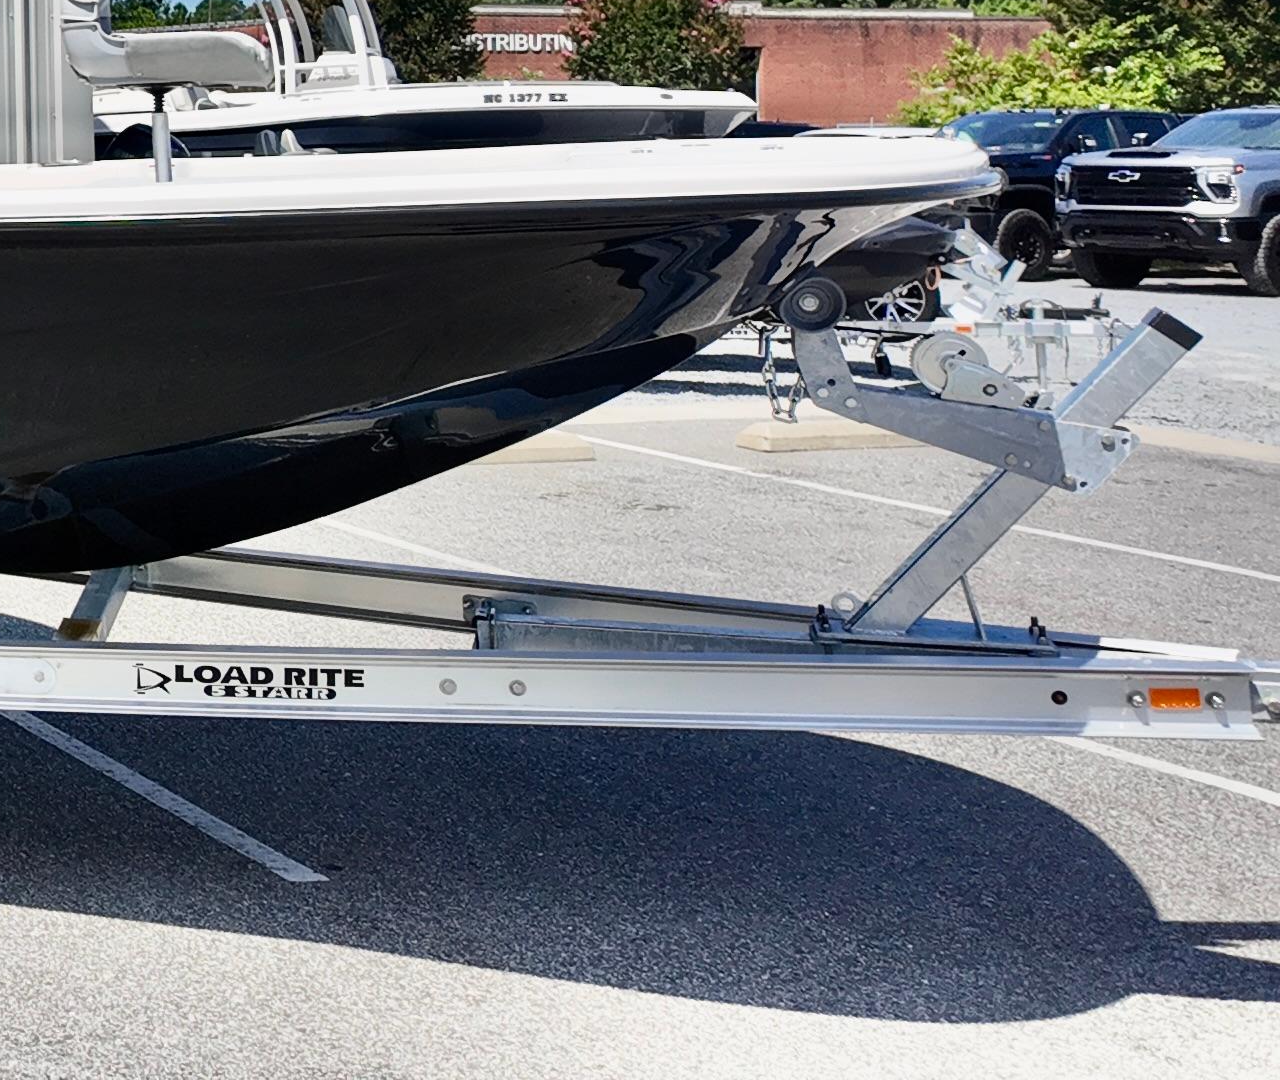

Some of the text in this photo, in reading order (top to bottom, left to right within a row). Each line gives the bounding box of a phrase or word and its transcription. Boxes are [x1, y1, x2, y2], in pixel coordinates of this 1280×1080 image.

[174, 664, 365, 688] LOAD RITE
[210, 685, 330, 700] 5 STARR
